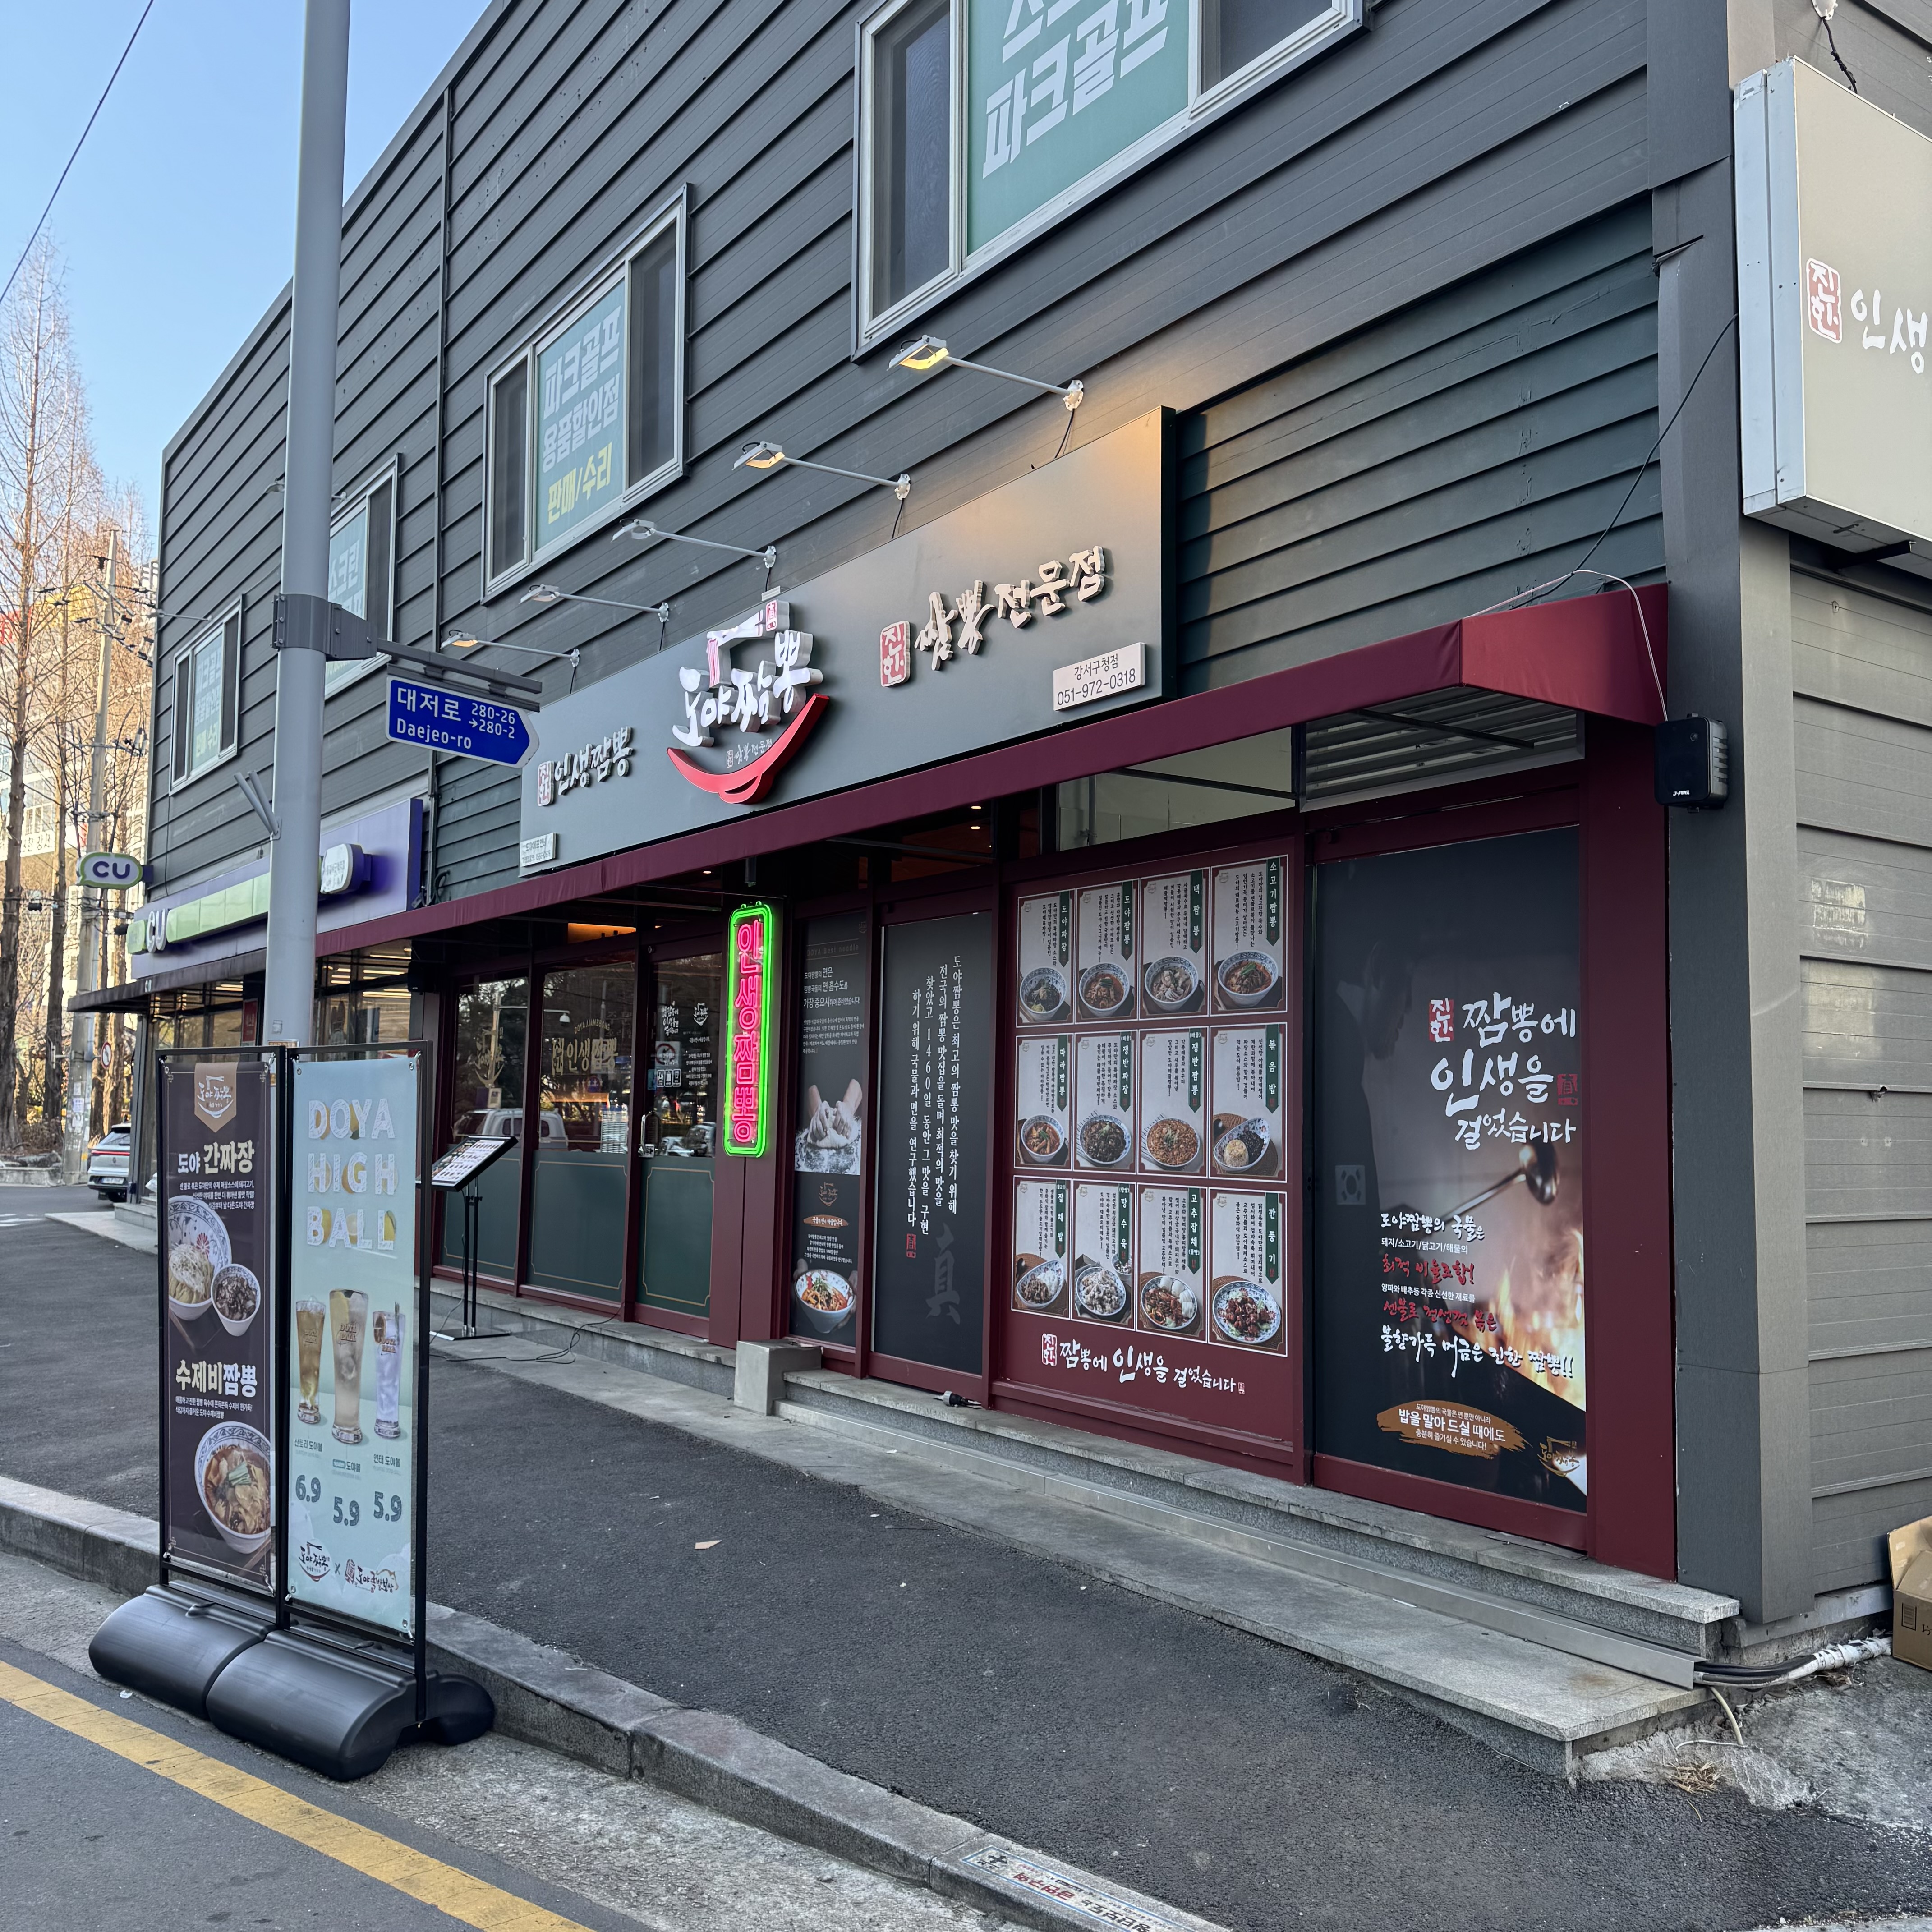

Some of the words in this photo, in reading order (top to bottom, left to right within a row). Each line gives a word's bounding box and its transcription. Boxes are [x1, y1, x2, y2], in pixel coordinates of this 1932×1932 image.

[983, 0, 1168, 179] 파크골프
[1851, 289, 1928, 374] 인생
[544, 305, 621, 420] 파크골프
[543, 373, 620, 474] 용품할인점
[548, 442, 612, 525] 판매/수리
[881, 621, 907, 686] 진한
[1074, 654, 1118, 681] 강서구청점
[1057, 668, 1136, 706] 051-972-0318
[397, 687, 461, 722] 대저로
[471, 703, 515, 724] 280-26
[397, 718, 472, 749] Daejeo-ro
[479, 719, 515, 739] 280-2
[554, 726, 633, 796] 인생짬뽕
[93, 860, 130, 878] CU
[147, 907, 169, 953] CU
[839, 944, 859, 952] noodle
[823, 967, 833, 978] 면은
[823, 981, 828, 992] 면
[938, 964, 948, 1009] 전국의
[804, 998, 814, 1009] 가장
[912, 989, 922, 1018] 하기
[925, 975, 935, 1019] 찾았고
[952, 956, 963, 1030] 도야짬뽕은
[733, 920, 759, 1143] 인생짬뽕
[911, 1021, 920, 1051] 위해
[938, 1012, 948, 1043] 짬뽕
[1430, 998, 1454, 1043] 진한
[1462, 992, 1576, 1048] 짬뽕에
[924, 1028, 932, 1108] 1460일
[937, 1045, 947, 1090] 맛집을
[950, 1033, 960, 1079] 최고의
[910, 1054, 920, 1098] 국물과
[1431, 1049, 1554, 1117] 인생을
[936, 1094, 945, 1124] 돌며
[950, 1081, 961, 1113] 짬뽕
[308, 1098, 395, 1139] DOYA
[909, 1101, 918, 1131] 면을
[922, 1115, 931, 1145] 동안
[950, 1116, 960, 1146] 맛을
[1454, 1108, 1577, 1150] 걸었습니다
[178, 1152, 200, 1174] 도야
[203, 1140, 255, 1174] 간짜장
[922, 1149, 930, 1161] 그
[935, 1127, 944, 1173] 최적의
[949, 1149, 959, 1181] 찾기
[308, 1152, 395, 1195] HIGH
[907, 1136, 917, 1228] 연구했습니다
[921, 1166, 931, 1196] 맛을
[934, 1176, 944, 1206] 맛을
[948, 1183, 957, 1214] 위해
[307, 1206, 394, 1250] BALL
[920, 1205, 929, 1235] 구현
[1381, 1212, 1445, 1234] 도야짬뽕의
[1451, 1215, 1486, 1242] 국물은
[1381, 1237, 1468, 1255] 돼지/소고기/닭고기/해물의
[1383, 1253, 1410, 1277] 최적
[1415, 1259, 1474, 1285] 비율조합!
[1381, 1283, 1400, 1294] 양파와
[1401, 1286, 1420, 1296] 배추등
[1421, 1288, 1434, 1298] 각종
[1435, 1290, 1454, 1301] 신선한
[1455, 1293, 1476, 1303] 재료를
[1384, 1297, 1419, 1321] 센불로
[1474, 1310, 1497, 1332] 볶은
[1059, 1339, 1108, 1372] 짬뽕에
[1113, 1345, 1169, 1383] 인생을
[1173, 1365, 1236, 1393] 걸었습니다
[1381, 1325, 1436, 1362] 불향가득
[1442, 1335, 1484, 1378] 머금은
[1488, 1346, 1523, 1368] 진한
[1527, 1350, 1573, 1375] 짬뽕!!
[176, 1359, 258, 1398] 수제비짬뽕
[1399, 1408, 1421, 1426] 밥을
[1423, 1414, 1445, 1431] 말아
[1447, 1419, 1470, 1436] 드실
[1473, 1425, 1506, 1442] 때에도
[1441, 1408, 1457, 1418] 국물은
[1475, 1415, 1491, 1424] 아니라
[309, 1441, 322, 1452] 도야볼
[1416, 1429, 1433, 1440] 충분히
[1434, 1432, 1452, 1444] 즐기실
[1460, 1438, 1486, 1450] 있습니다!
[346, 1461, 361, 1473] 도야볼
[385, 1456, 400, 1468] 도야볼
[296, 1475, 321, 1503] 6.9
[333, 1496, 360, 1527] 5.9
[373, 1491, 402, 1522] 5.9
[1013, 1872, 1076, 1900] 금연구역
